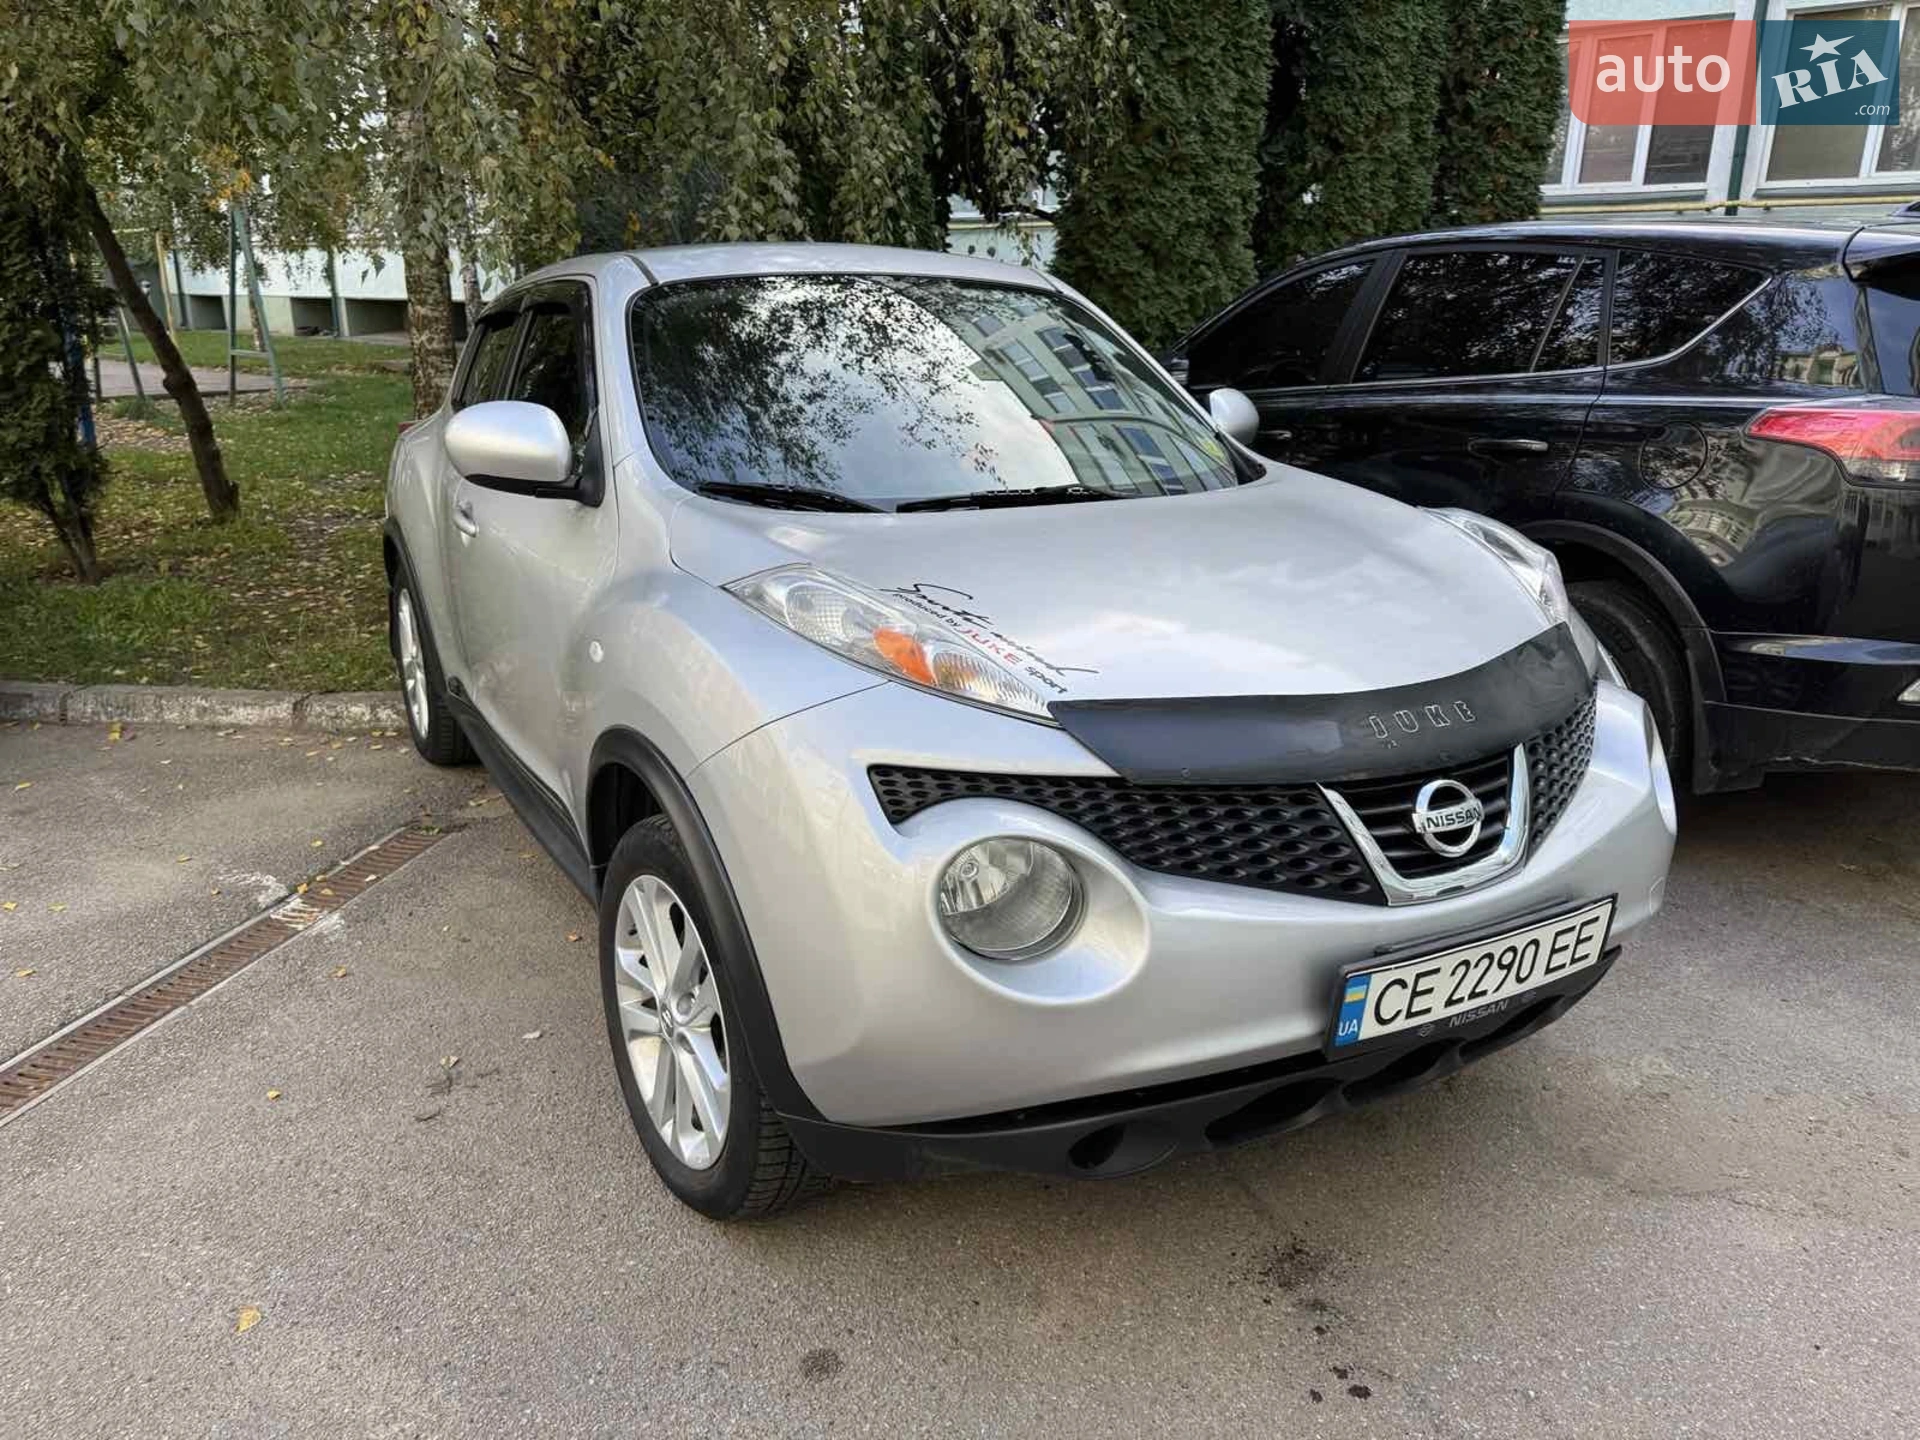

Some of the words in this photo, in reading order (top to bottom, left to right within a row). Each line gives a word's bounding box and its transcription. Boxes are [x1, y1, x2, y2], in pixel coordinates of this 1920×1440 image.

[960, 627, 1024, 666] JUKE
[1426, 803, 1482, 829] NISSAN
[1338, 1020, 1358, 1037] UA
[1374, 967, 1441, 1027] CE
[1444, 938, 1541, 1009] 2290
[1544, 916, 1600, 976] EE
[1450, 999, 1509, 1028] NISSAN
